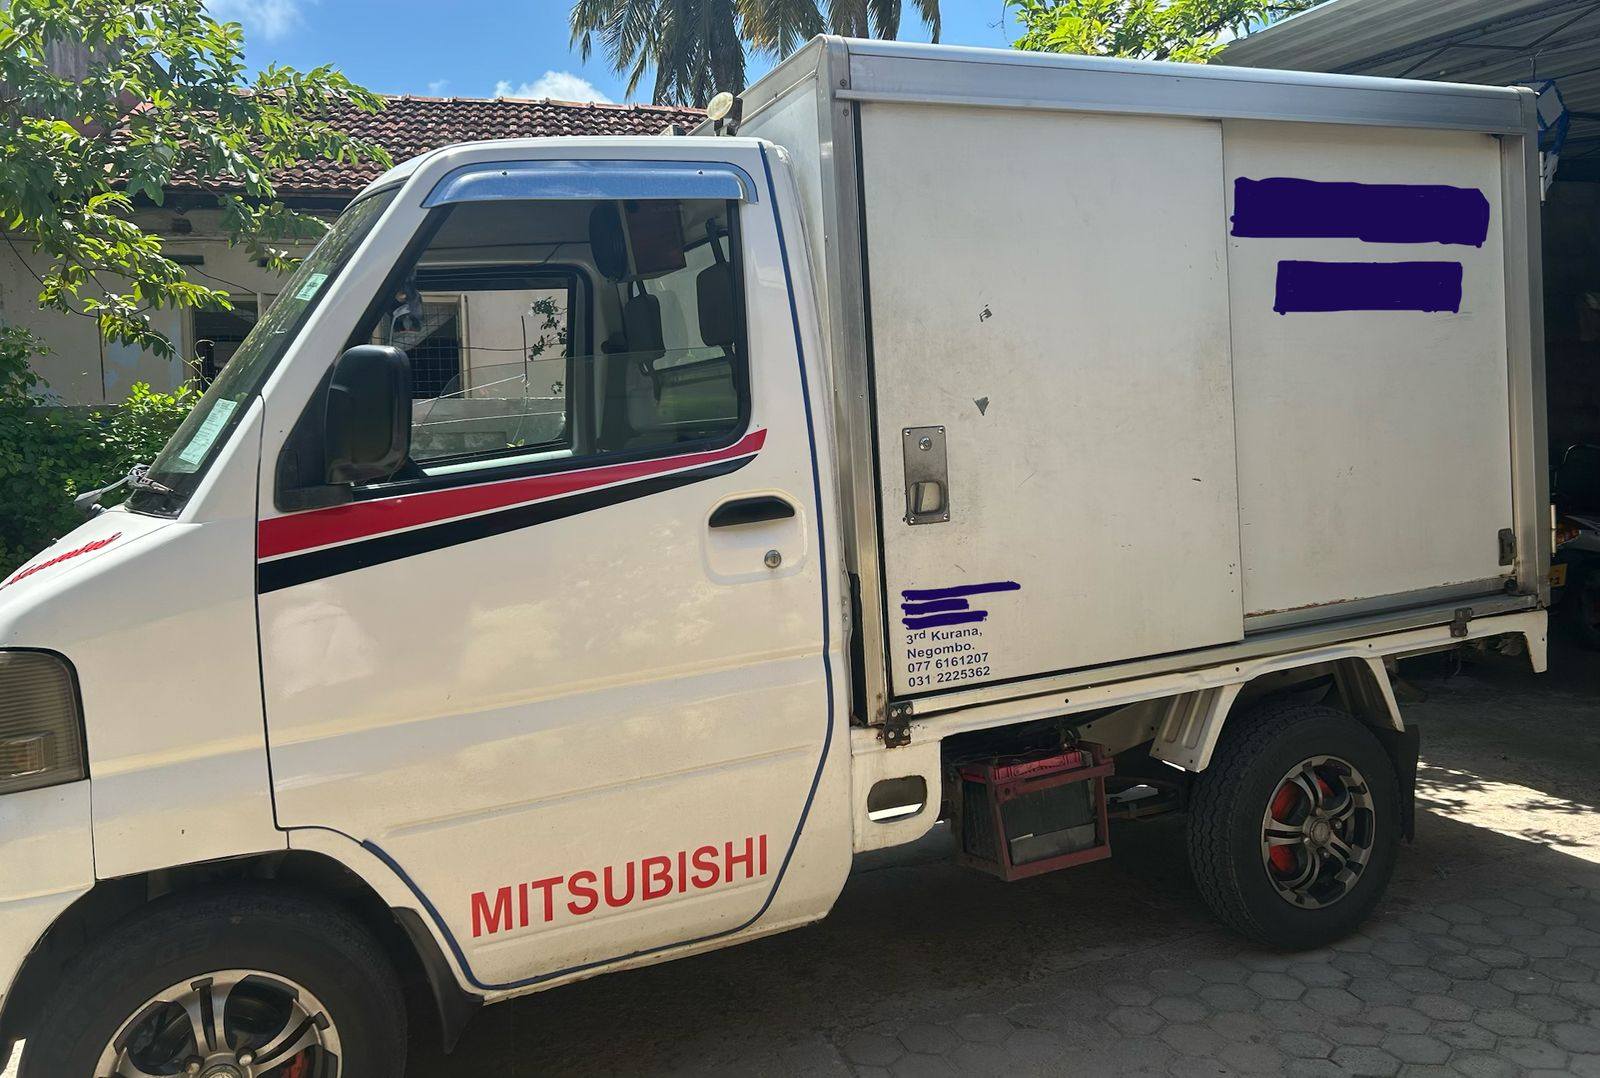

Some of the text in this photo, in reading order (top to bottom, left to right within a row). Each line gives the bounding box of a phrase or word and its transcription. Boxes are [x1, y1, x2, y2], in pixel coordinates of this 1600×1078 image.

[906, 627, 983, 645] 3rd Kurana,
[907, 643, 975, 659] Negombo.
[908, 652, 989, 673] 077 6161207
[908, 666, 990, 687] 031 2225362
[470, 834, 768, 938] MITSUBISHI
